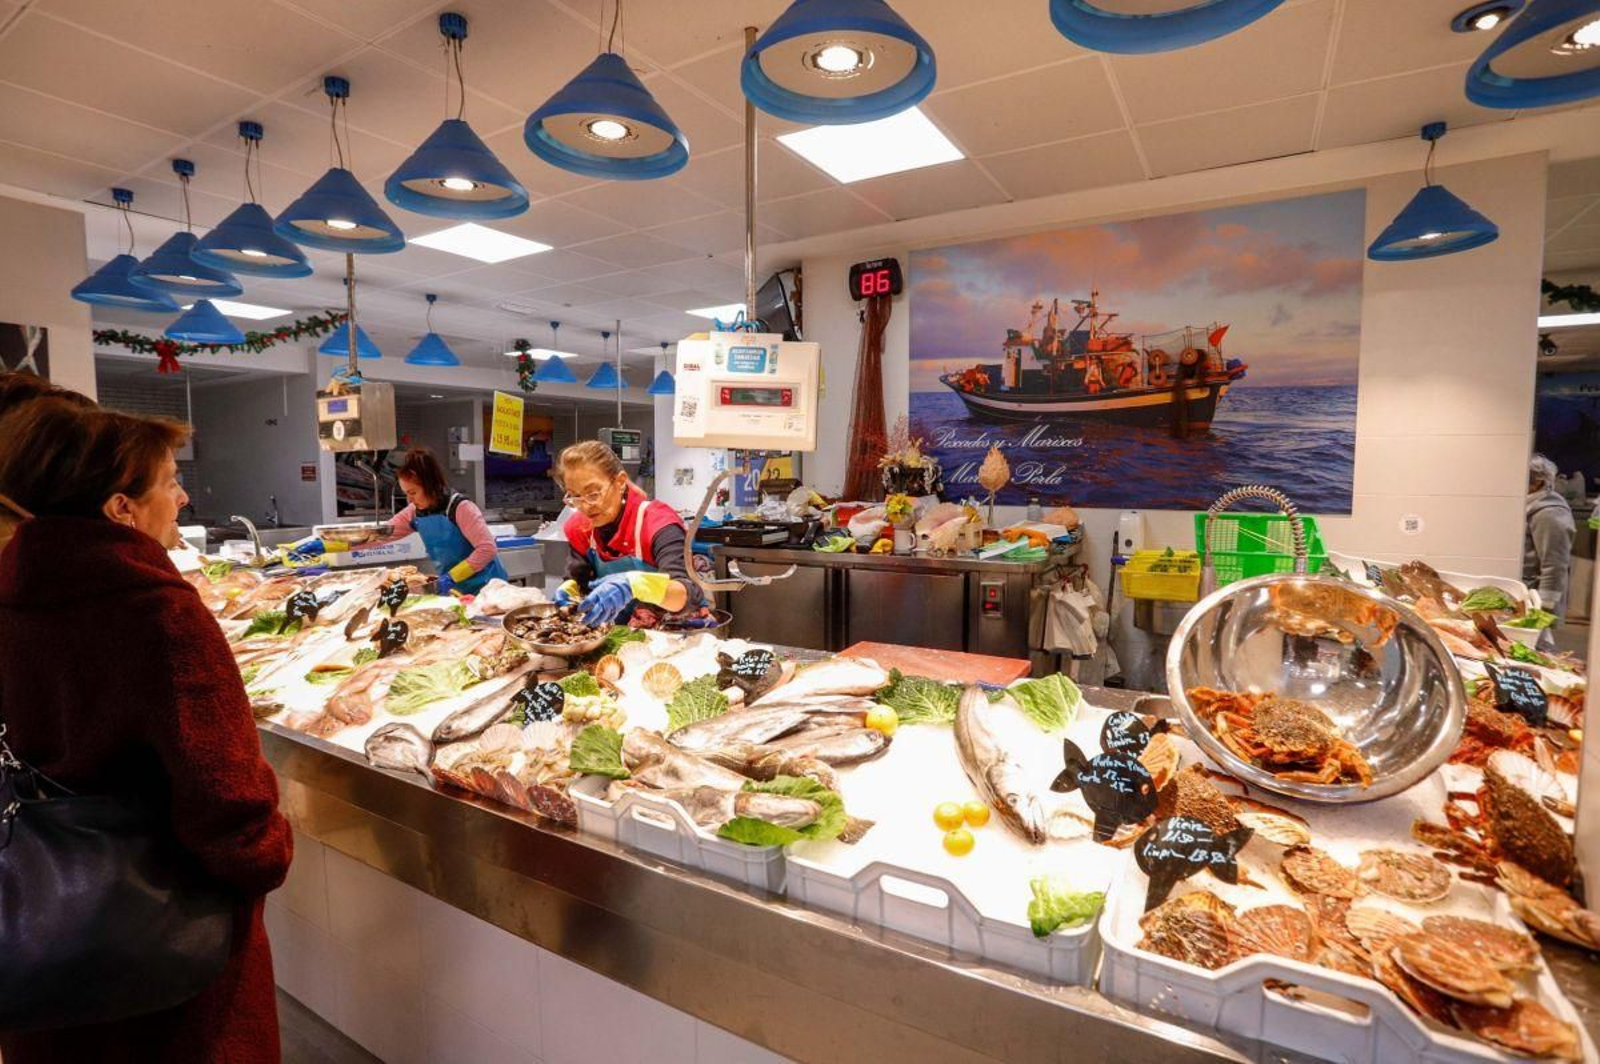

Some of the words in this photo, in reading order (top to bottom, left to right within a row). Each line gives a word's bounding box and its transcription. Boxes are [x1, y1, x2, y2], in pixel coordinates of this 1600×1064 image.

[929, 426, 991, 449] Pescados
[1008, 424, 1083, 449] Mariscos
[1011, 460, 1067, 485] Perla
